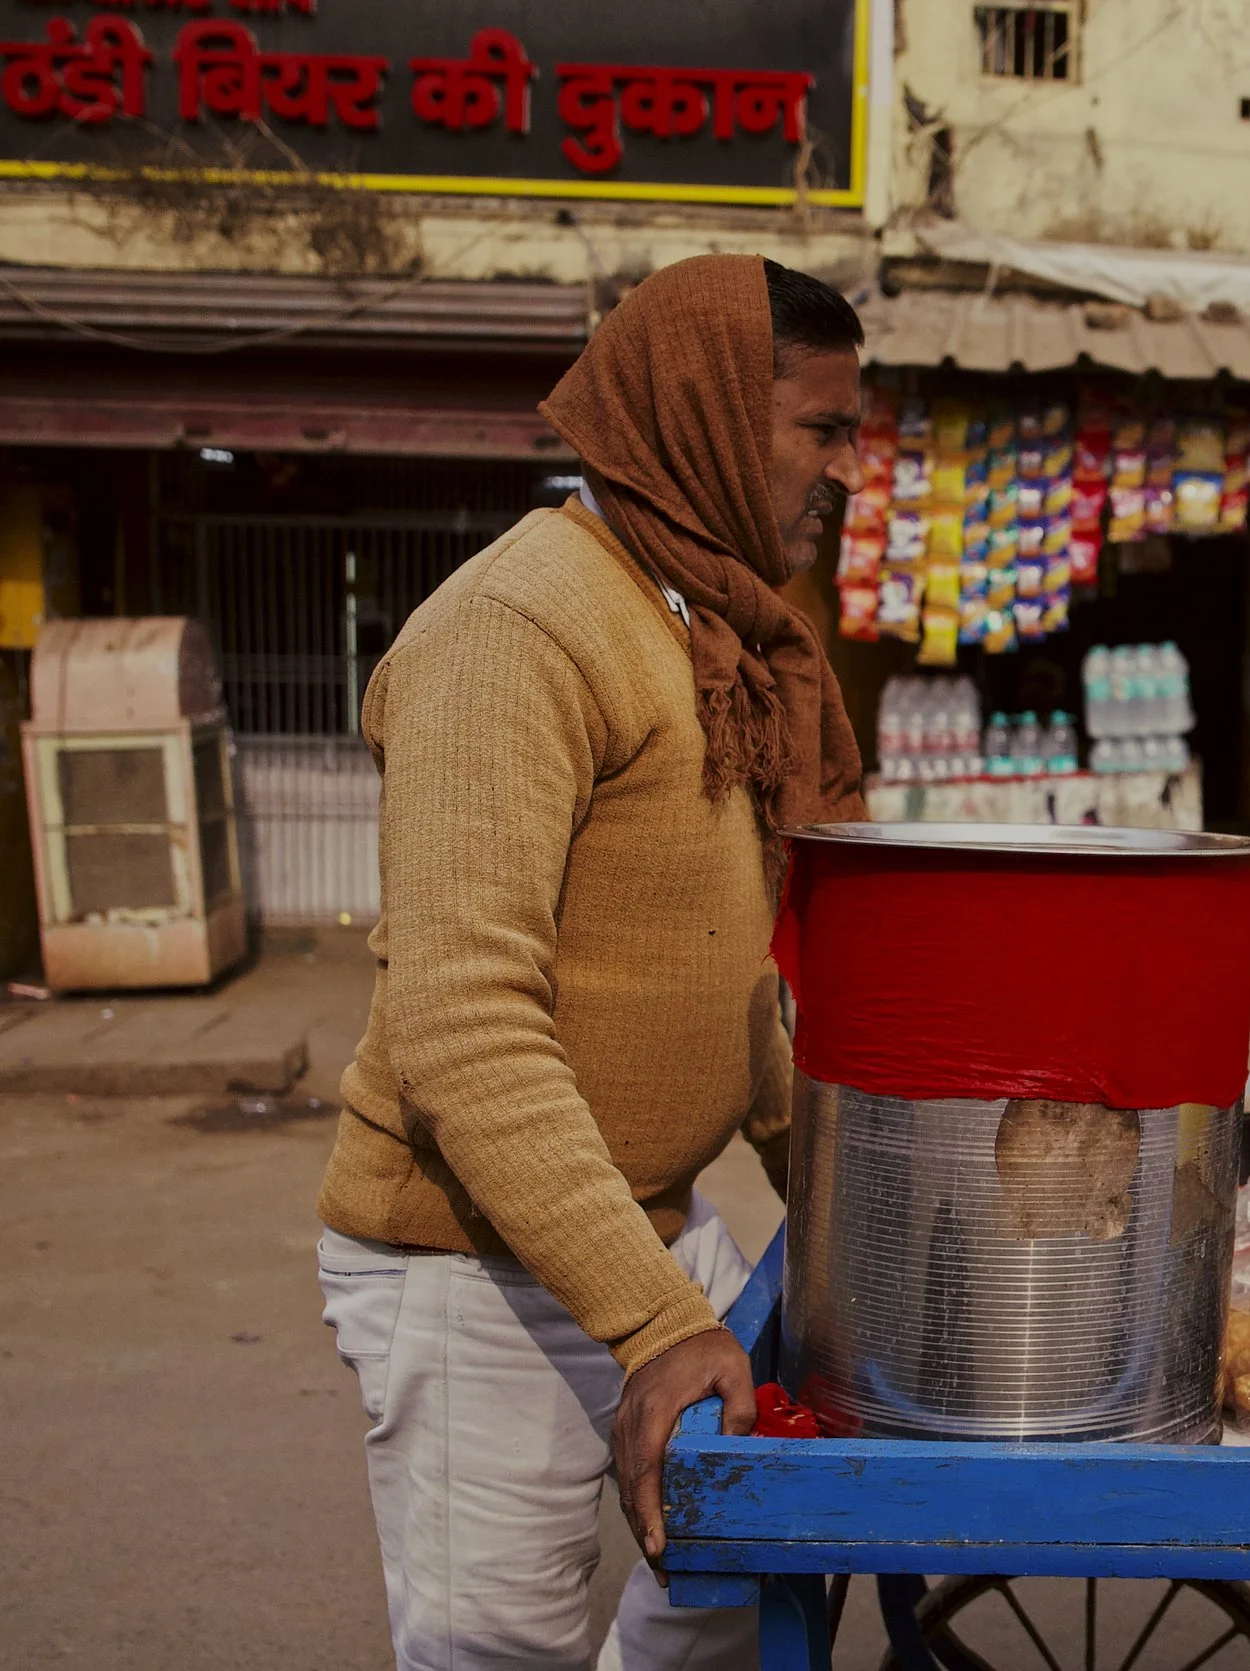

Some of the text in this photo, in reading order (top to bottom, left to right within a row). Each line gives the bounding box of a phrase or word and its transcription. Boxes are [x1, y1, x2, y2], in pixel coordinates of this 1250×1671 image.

[0, 14, 816, 176] ठंडी बियर की दुकान
